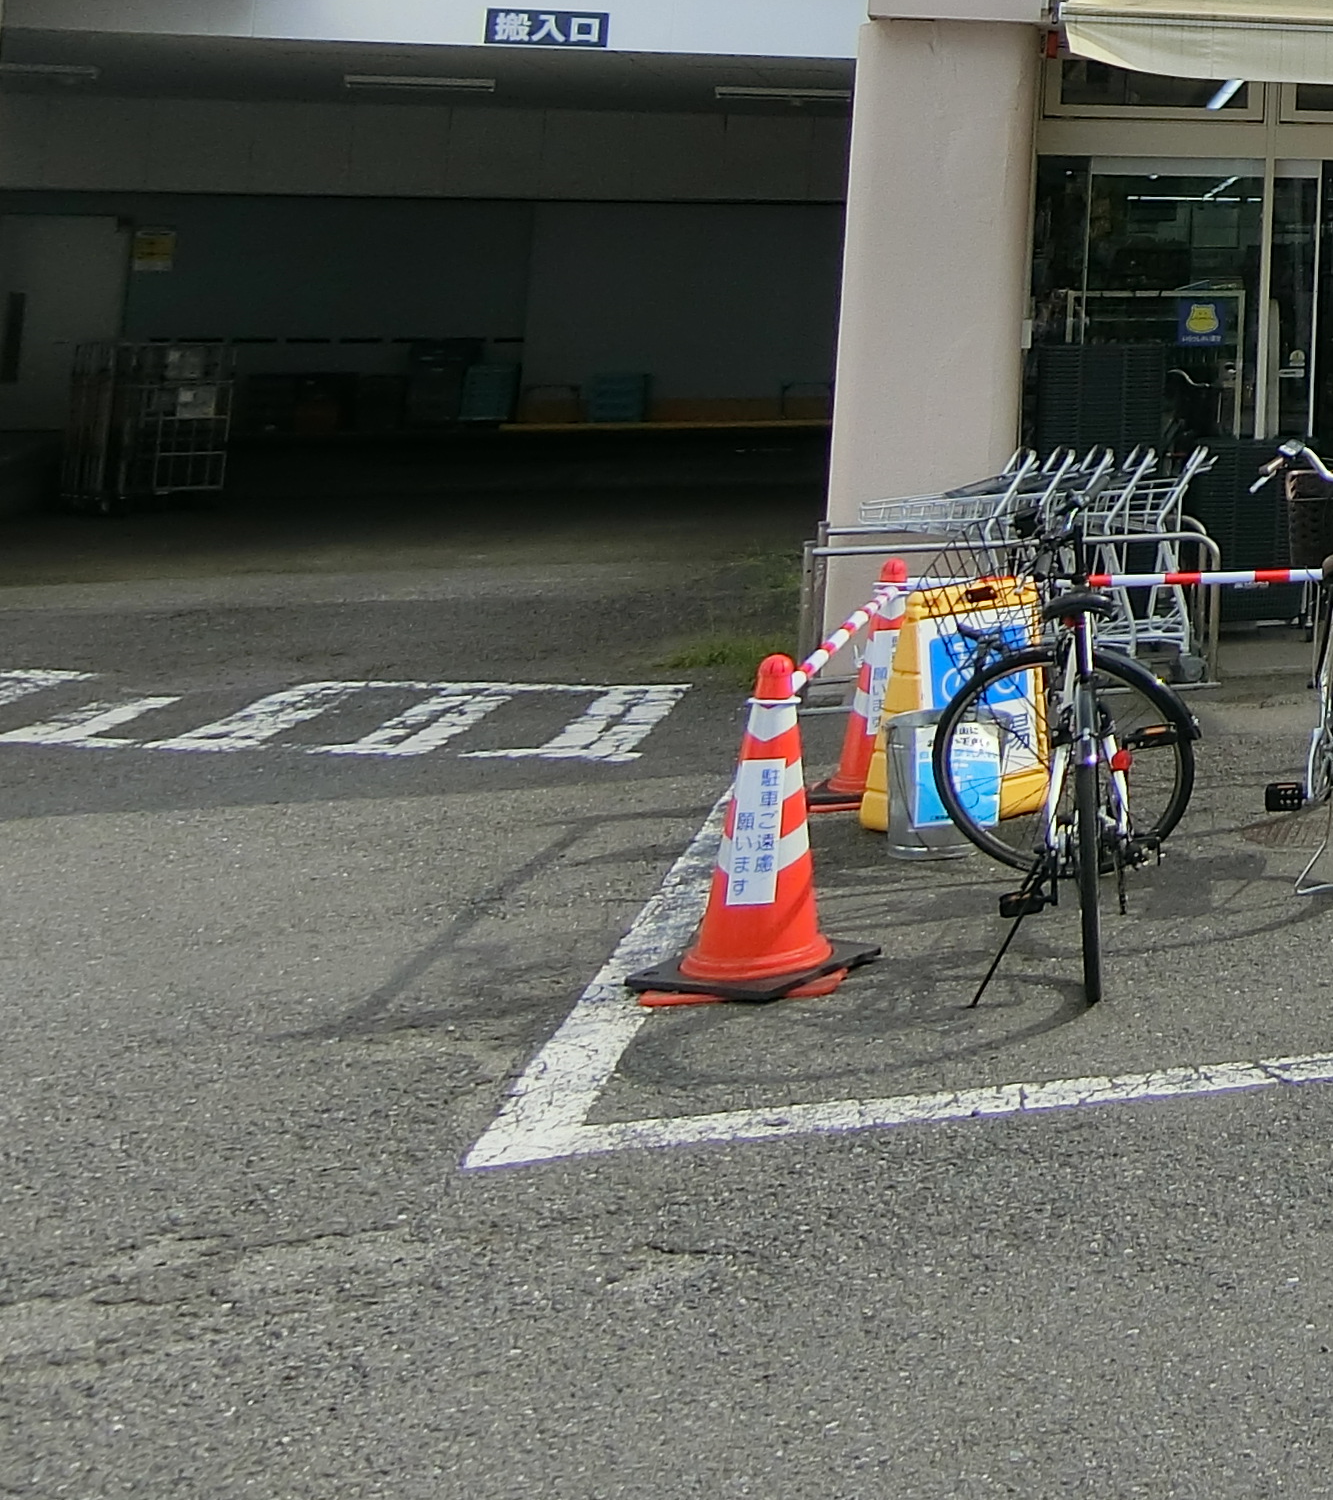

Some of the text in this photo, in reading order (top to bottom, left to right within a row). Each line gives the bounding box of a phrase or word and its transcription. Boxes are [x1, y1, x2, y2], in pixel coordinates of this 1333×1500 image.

[494, 12, 601, 43] 搬入口
[732, 812, 756, 896] 願います
[754, 768, 781, 874] 駐車ご遠慮
